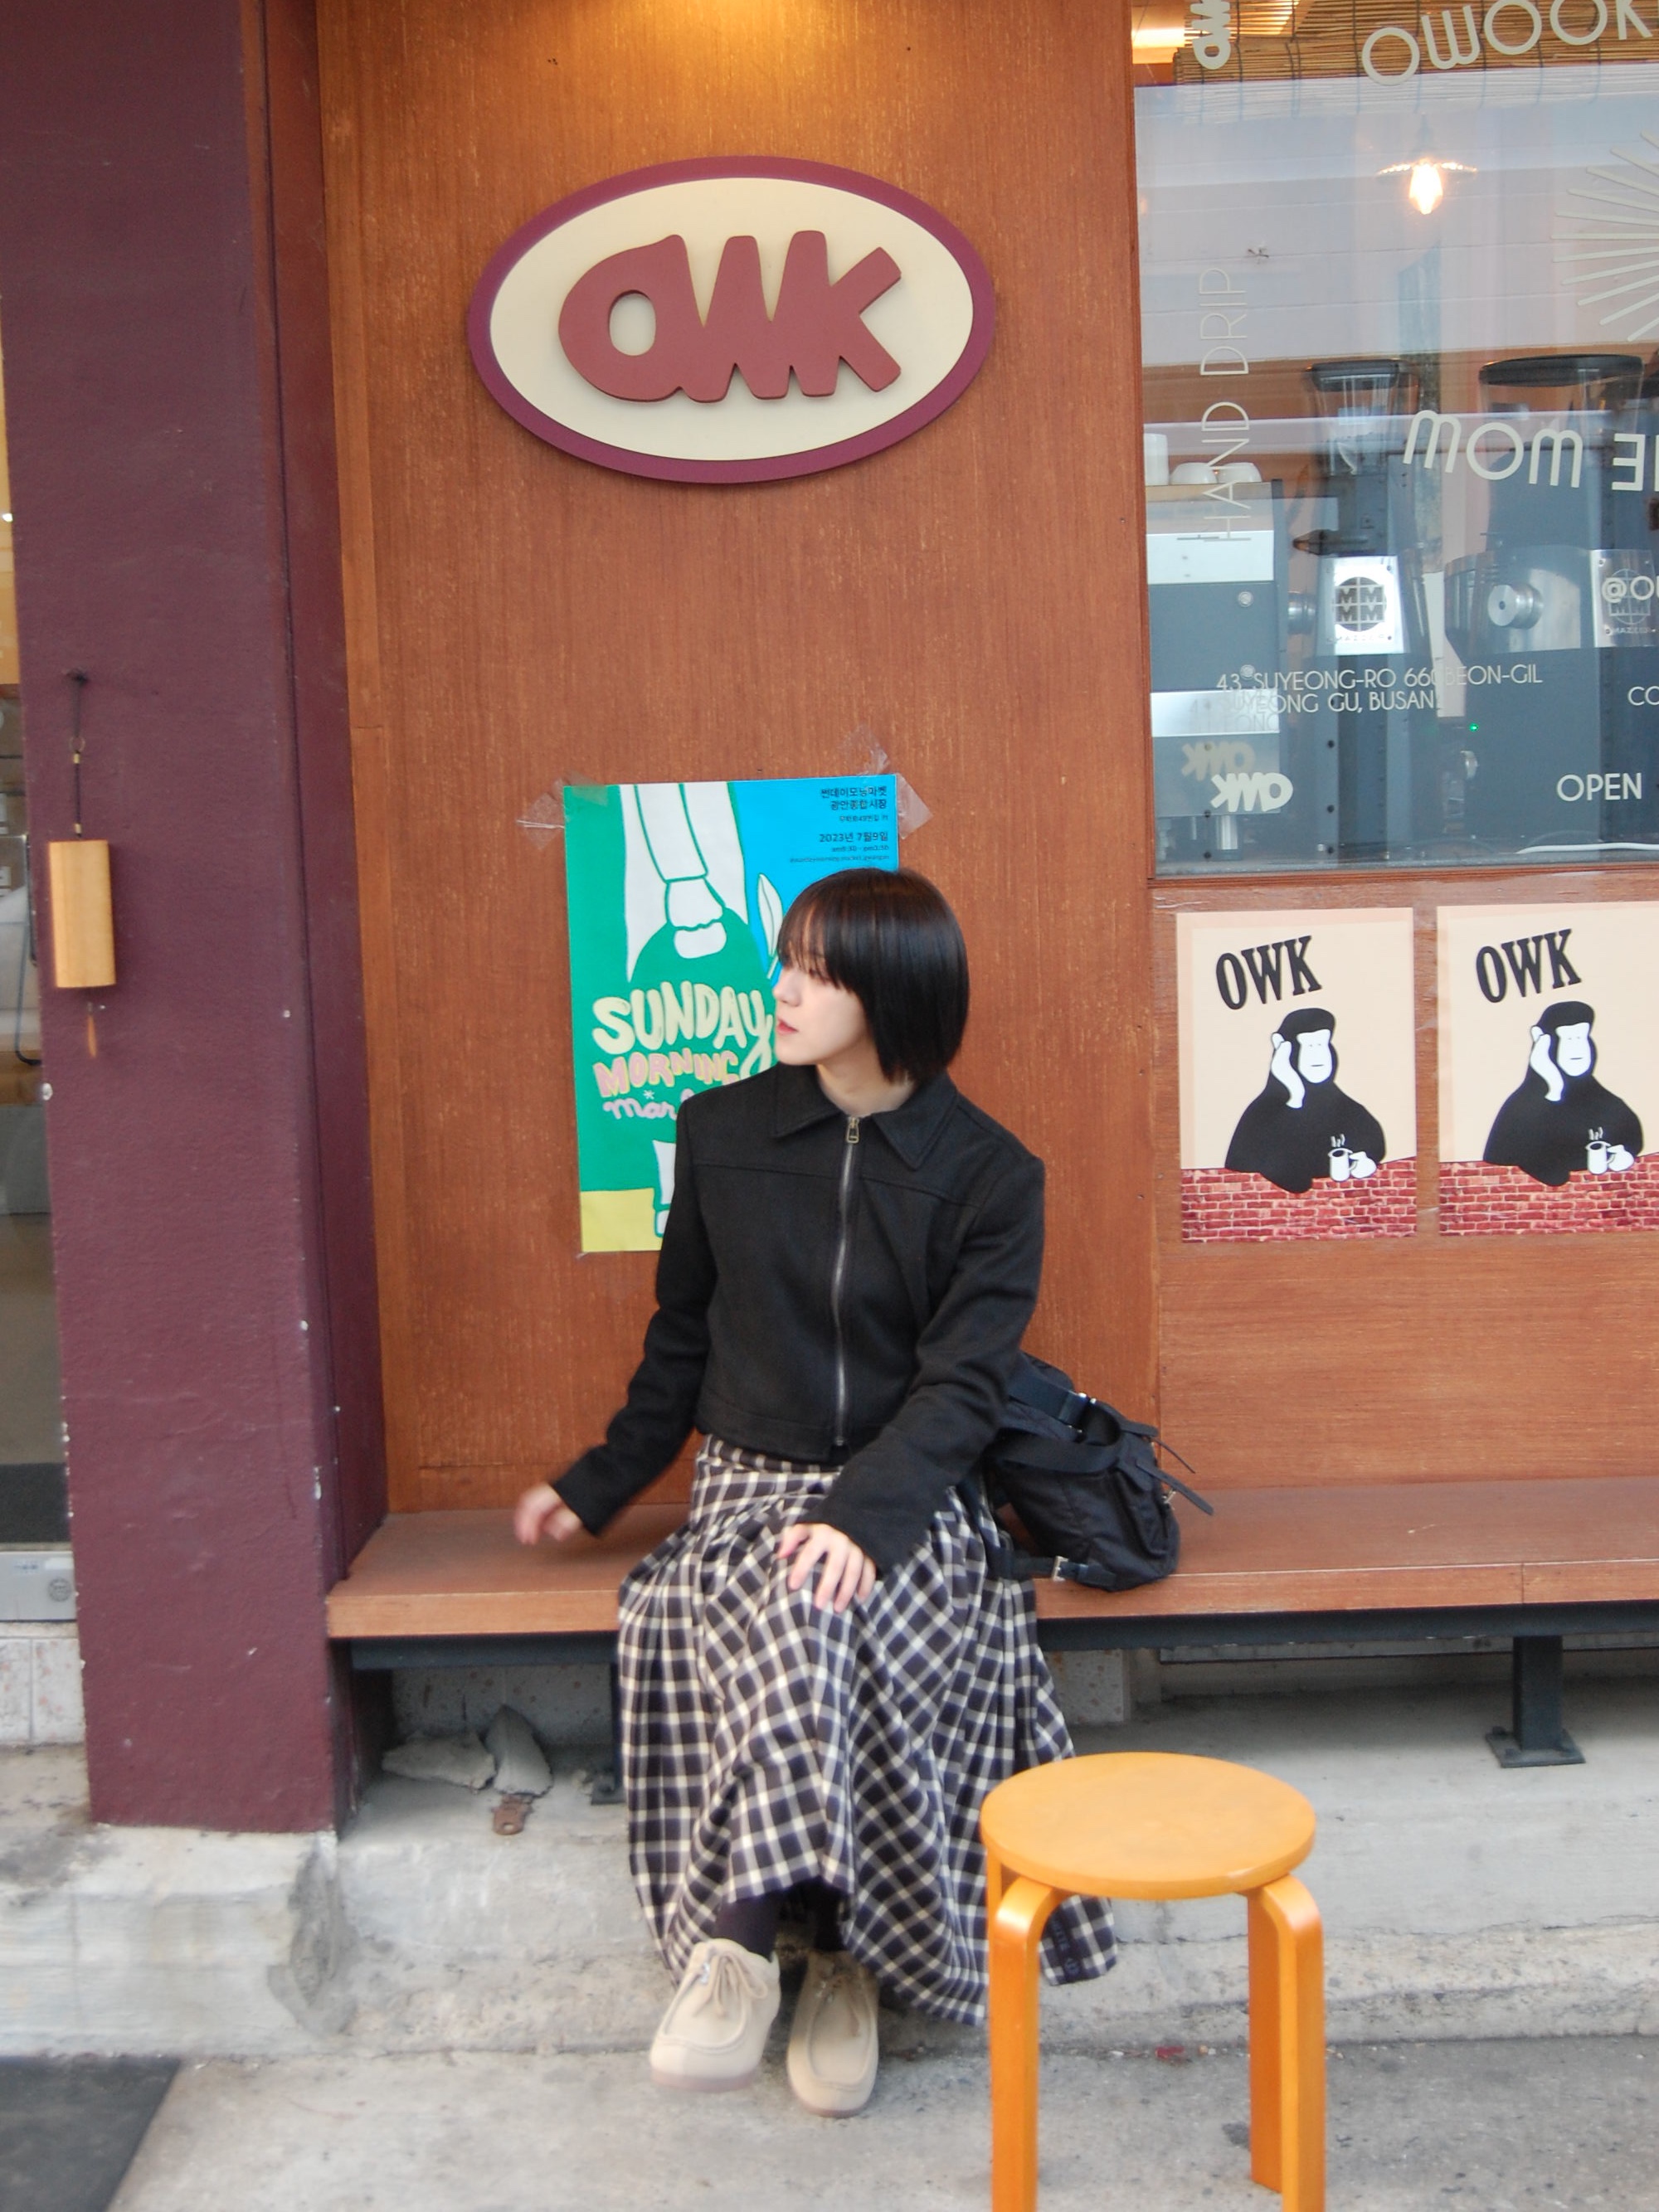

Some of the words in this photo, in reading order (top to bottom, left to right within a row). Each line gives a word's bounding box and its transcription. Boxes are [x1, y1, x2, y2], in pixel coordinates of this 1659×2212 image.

[558, 230, 902, 403] OWK
[1199, 268, 1249, 376] DRIP
[1200, 401, 1251, 542] HAND
[1601, 575, 1659, 605] @O
[1216, 675, 1242, 691] 43
[1253, 668, 1398, 691] SUYEONG-RO
[1328, 692, 1363, 713] GU,
[1557, 772, 1643, 802] OPEN
[819, 832, 854, 843] 2023년
[1215, 934, 1323, 1011] OWK
[1475, 927, 1582, 1004] OWK
[591, 980, 774, 1081] SUNDAY
[591, 1048, 739, 1099] MORNING
